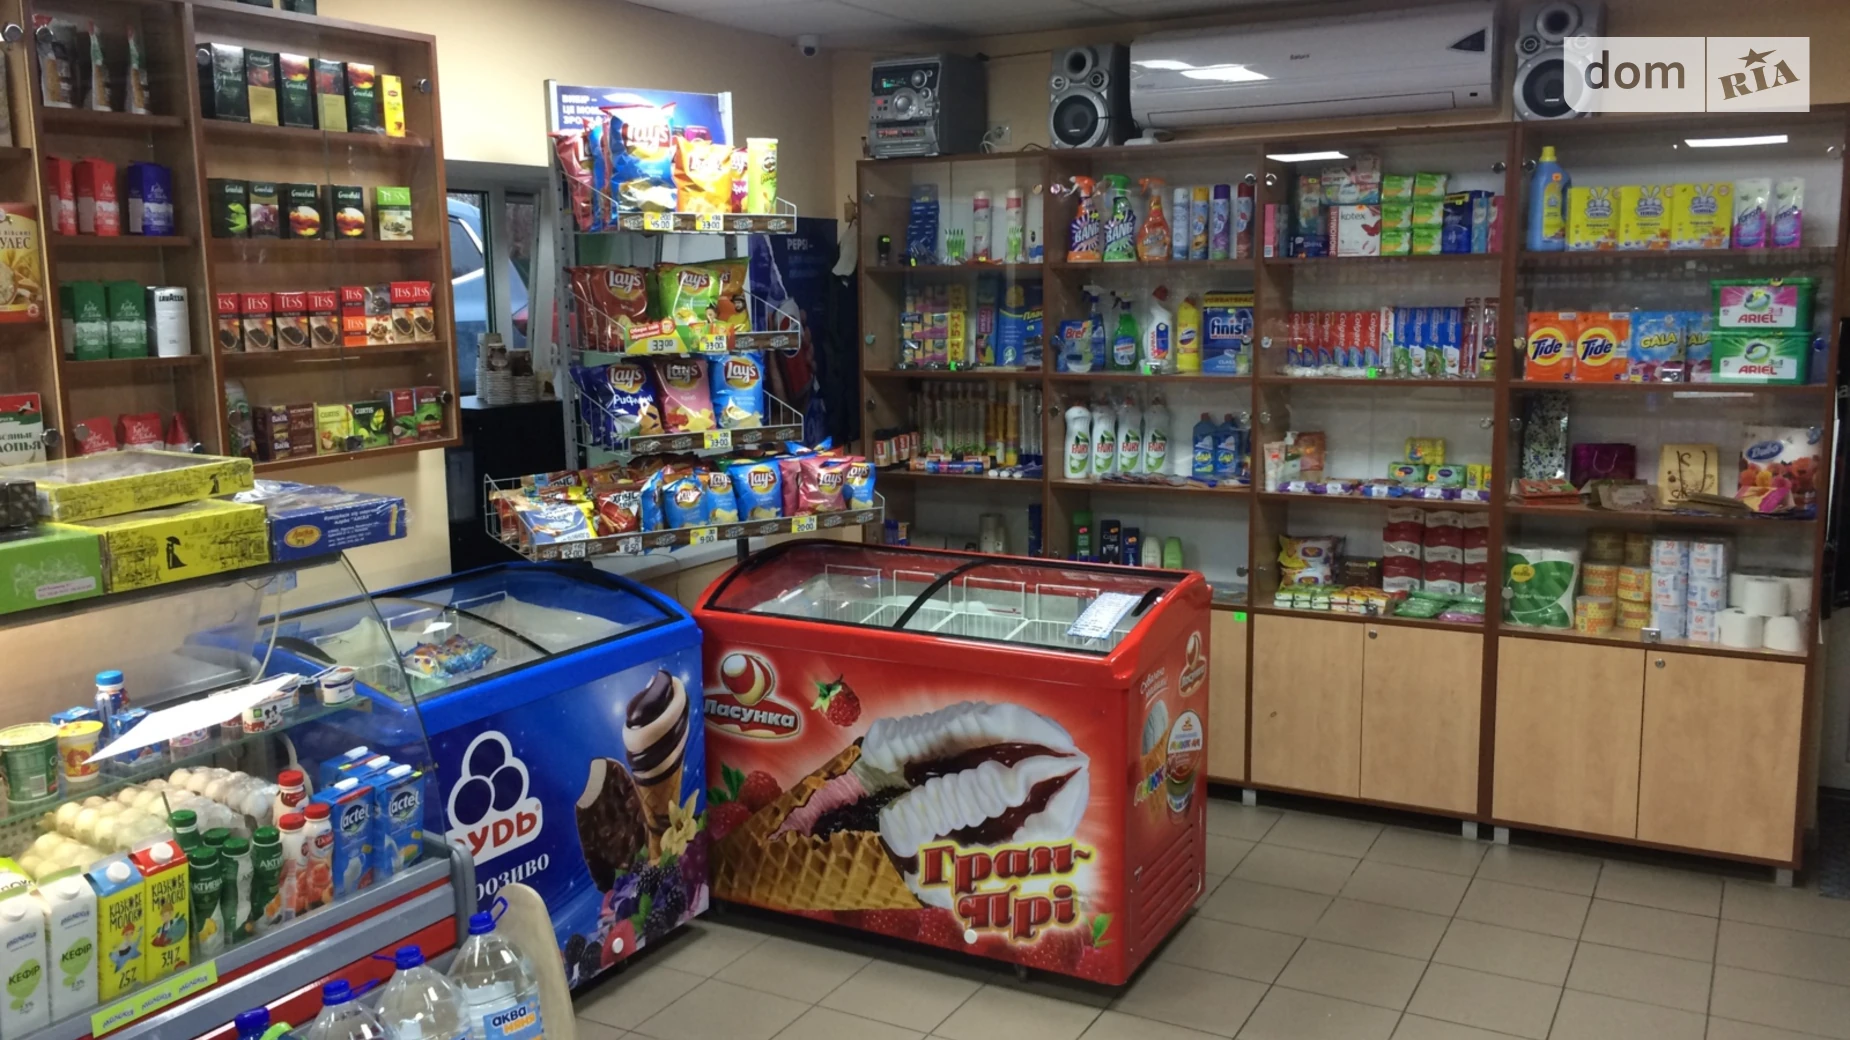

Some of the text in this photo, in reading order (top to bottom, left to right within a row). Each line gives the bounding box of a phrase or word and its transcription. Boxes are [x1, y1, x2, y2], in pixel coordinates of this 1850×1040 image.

[1341, 210, 1366, 221] kotex
[1075, 222, 1100, 242] BANG
[1106, 221, 1134, 242] BANG
[345, 288, 363, 301] TESS
[394, 286, 411, 298] TESS
[413, 286, 430, 297] TESS
[218, 297, 235, 310] ESS
[247, 297, 269, 311] TESS
[281, 295, 303, 309] TESS
[314, 295, 335, 308] TESS
[1738, 314, 1777, 324] ARIEL
[1065, 325, 1087, 339] Bref
[1370, 311, 1378, 346] Colgate
[1640, 334, 1677, 349] GALA
[1688, 334, 1711, 348] ALA
[1532, 339, 1563, 361] Tide
[1581, 339, 1613, 360] Tide
[1738, 365, 1777, 376] ARIEL
[355, 406, 375, 415] CURTIS
[1071, 443, 1089, 454] FAIRY
[1097, 443, 1114, 453] FAIRY
[1122, 442, 1140, 452] FAIRY
[1148, 441, 1166, 452] FAIRY
[704, 699, 796, 728] Ласунка
[389, 790, 421, 817] lactel
[340, 803, 371, 832] lactel
[922, 842, 1092, 895] Гран-
[152, 873, 186, 898] КАЗКОВЕ
[109, 891, 143, 919] КАЗКОВЕ
[152, 887, 187, 912] МОЛОКО
[109, 908, 143, 932] МОЛОКО
[61, 943, 93, 962] КЕФІР
[8, 964, 41, 986] КЕФІР
